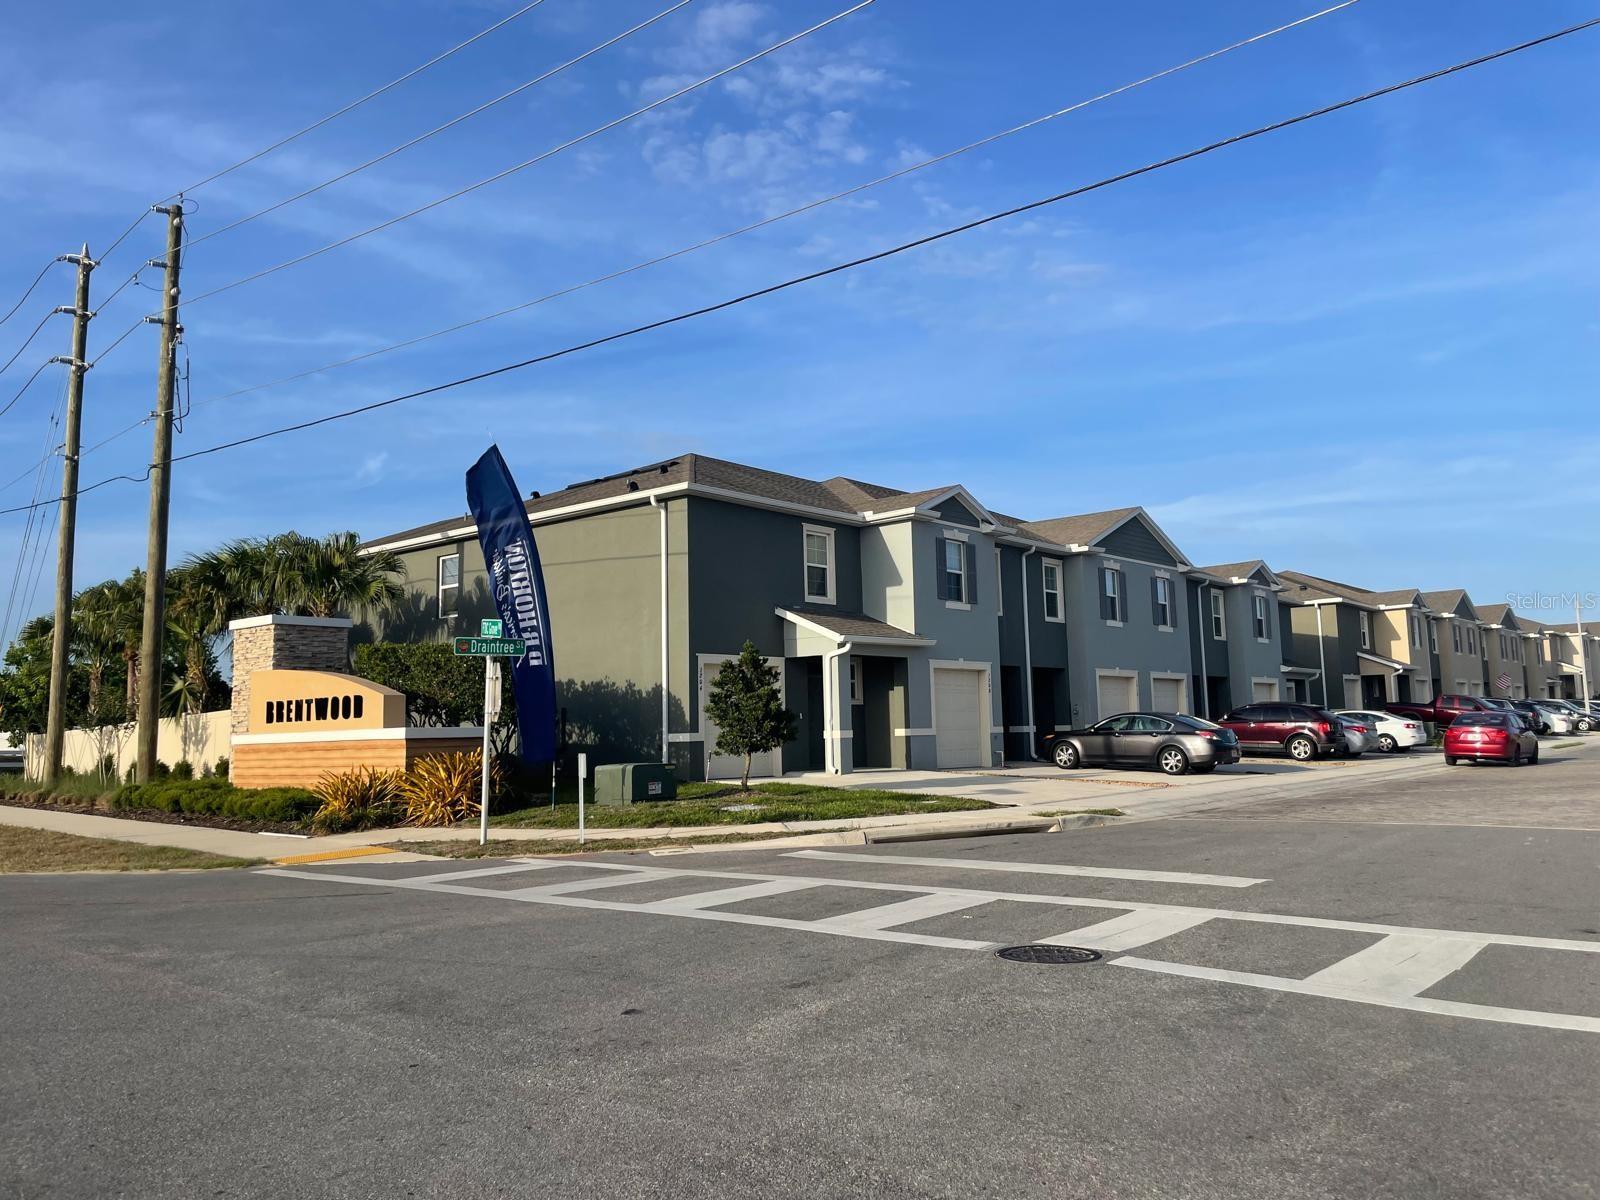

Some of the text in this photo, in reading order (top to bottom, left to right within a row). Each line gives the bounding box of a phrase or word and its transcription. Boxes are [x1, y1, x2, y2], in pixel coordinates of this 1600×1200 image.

[470, 639, 524, 653] Draintree St
[265, 694, 364, 724] BRENTWOOD
